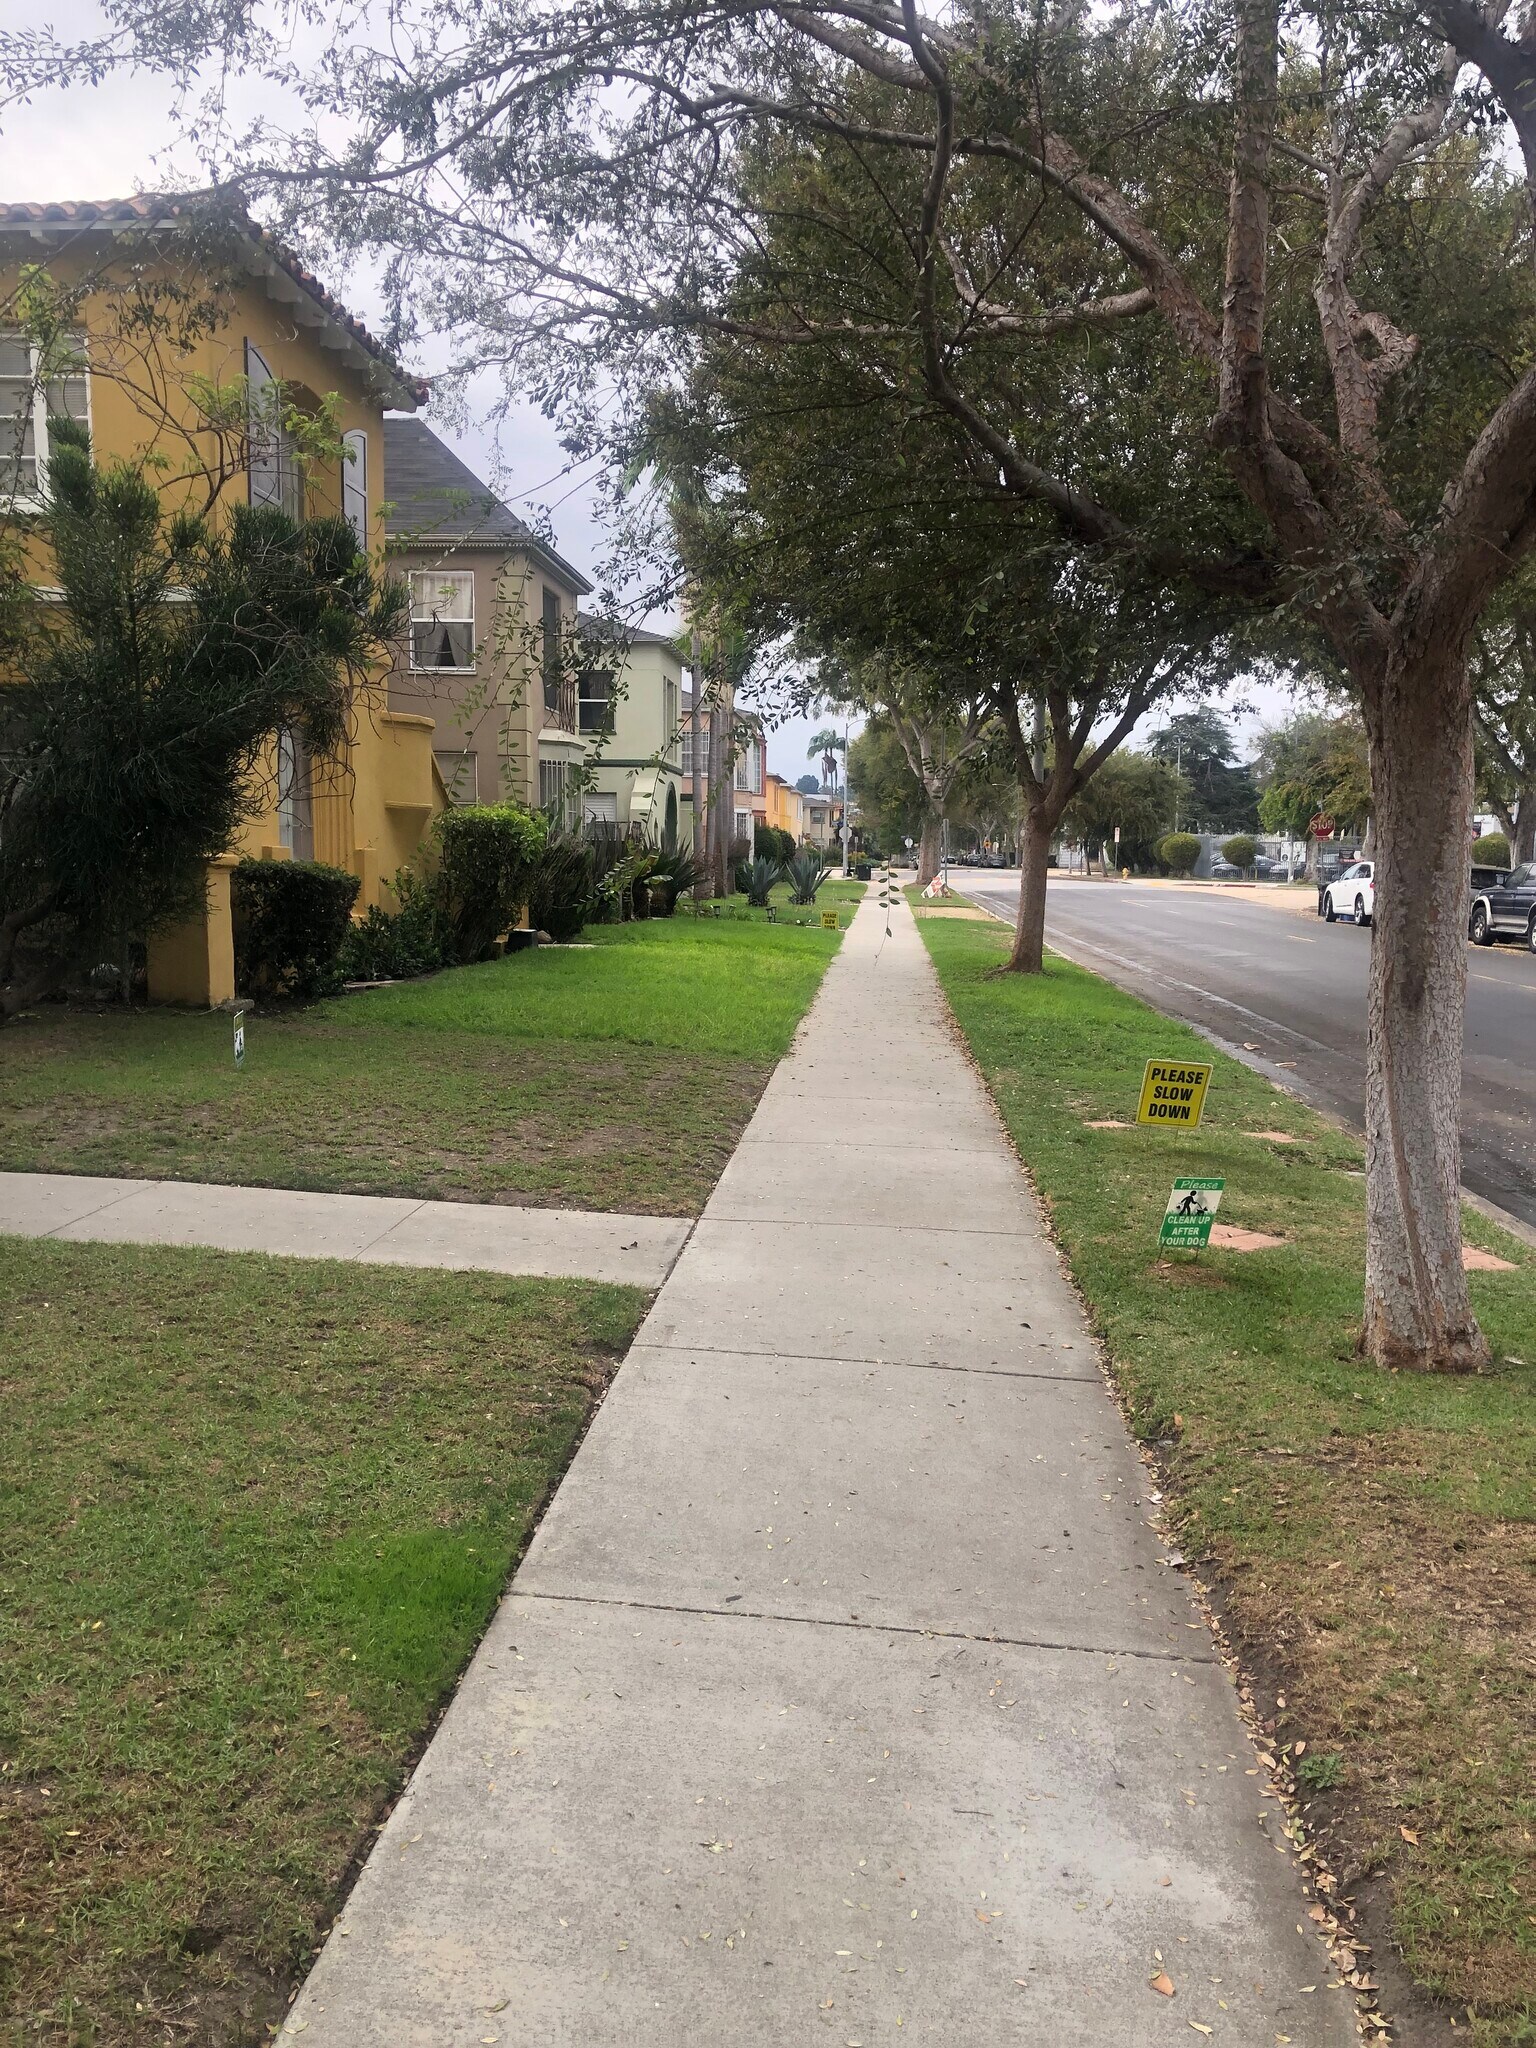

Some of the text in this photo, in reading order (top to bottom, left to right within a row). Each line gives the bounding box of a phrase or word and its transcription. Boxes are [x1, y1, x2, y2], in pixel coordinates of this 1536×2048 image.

[1311, 819, 1334, 831] STOP
[1151, 1067, 1204, 1085] PLEASE
[1153, 1085, 1194, 1102] SLOW
[1148, 1103, 1191, 1120] DOWN
[1180, 1179, 1219, 1190] Please
[1167, 1215, 1211, 1225] CLEAN UP
[1171, 1226, 1200, 1236] AFTER
[1161, 1236, 1206, 1247] YOUR DOG
